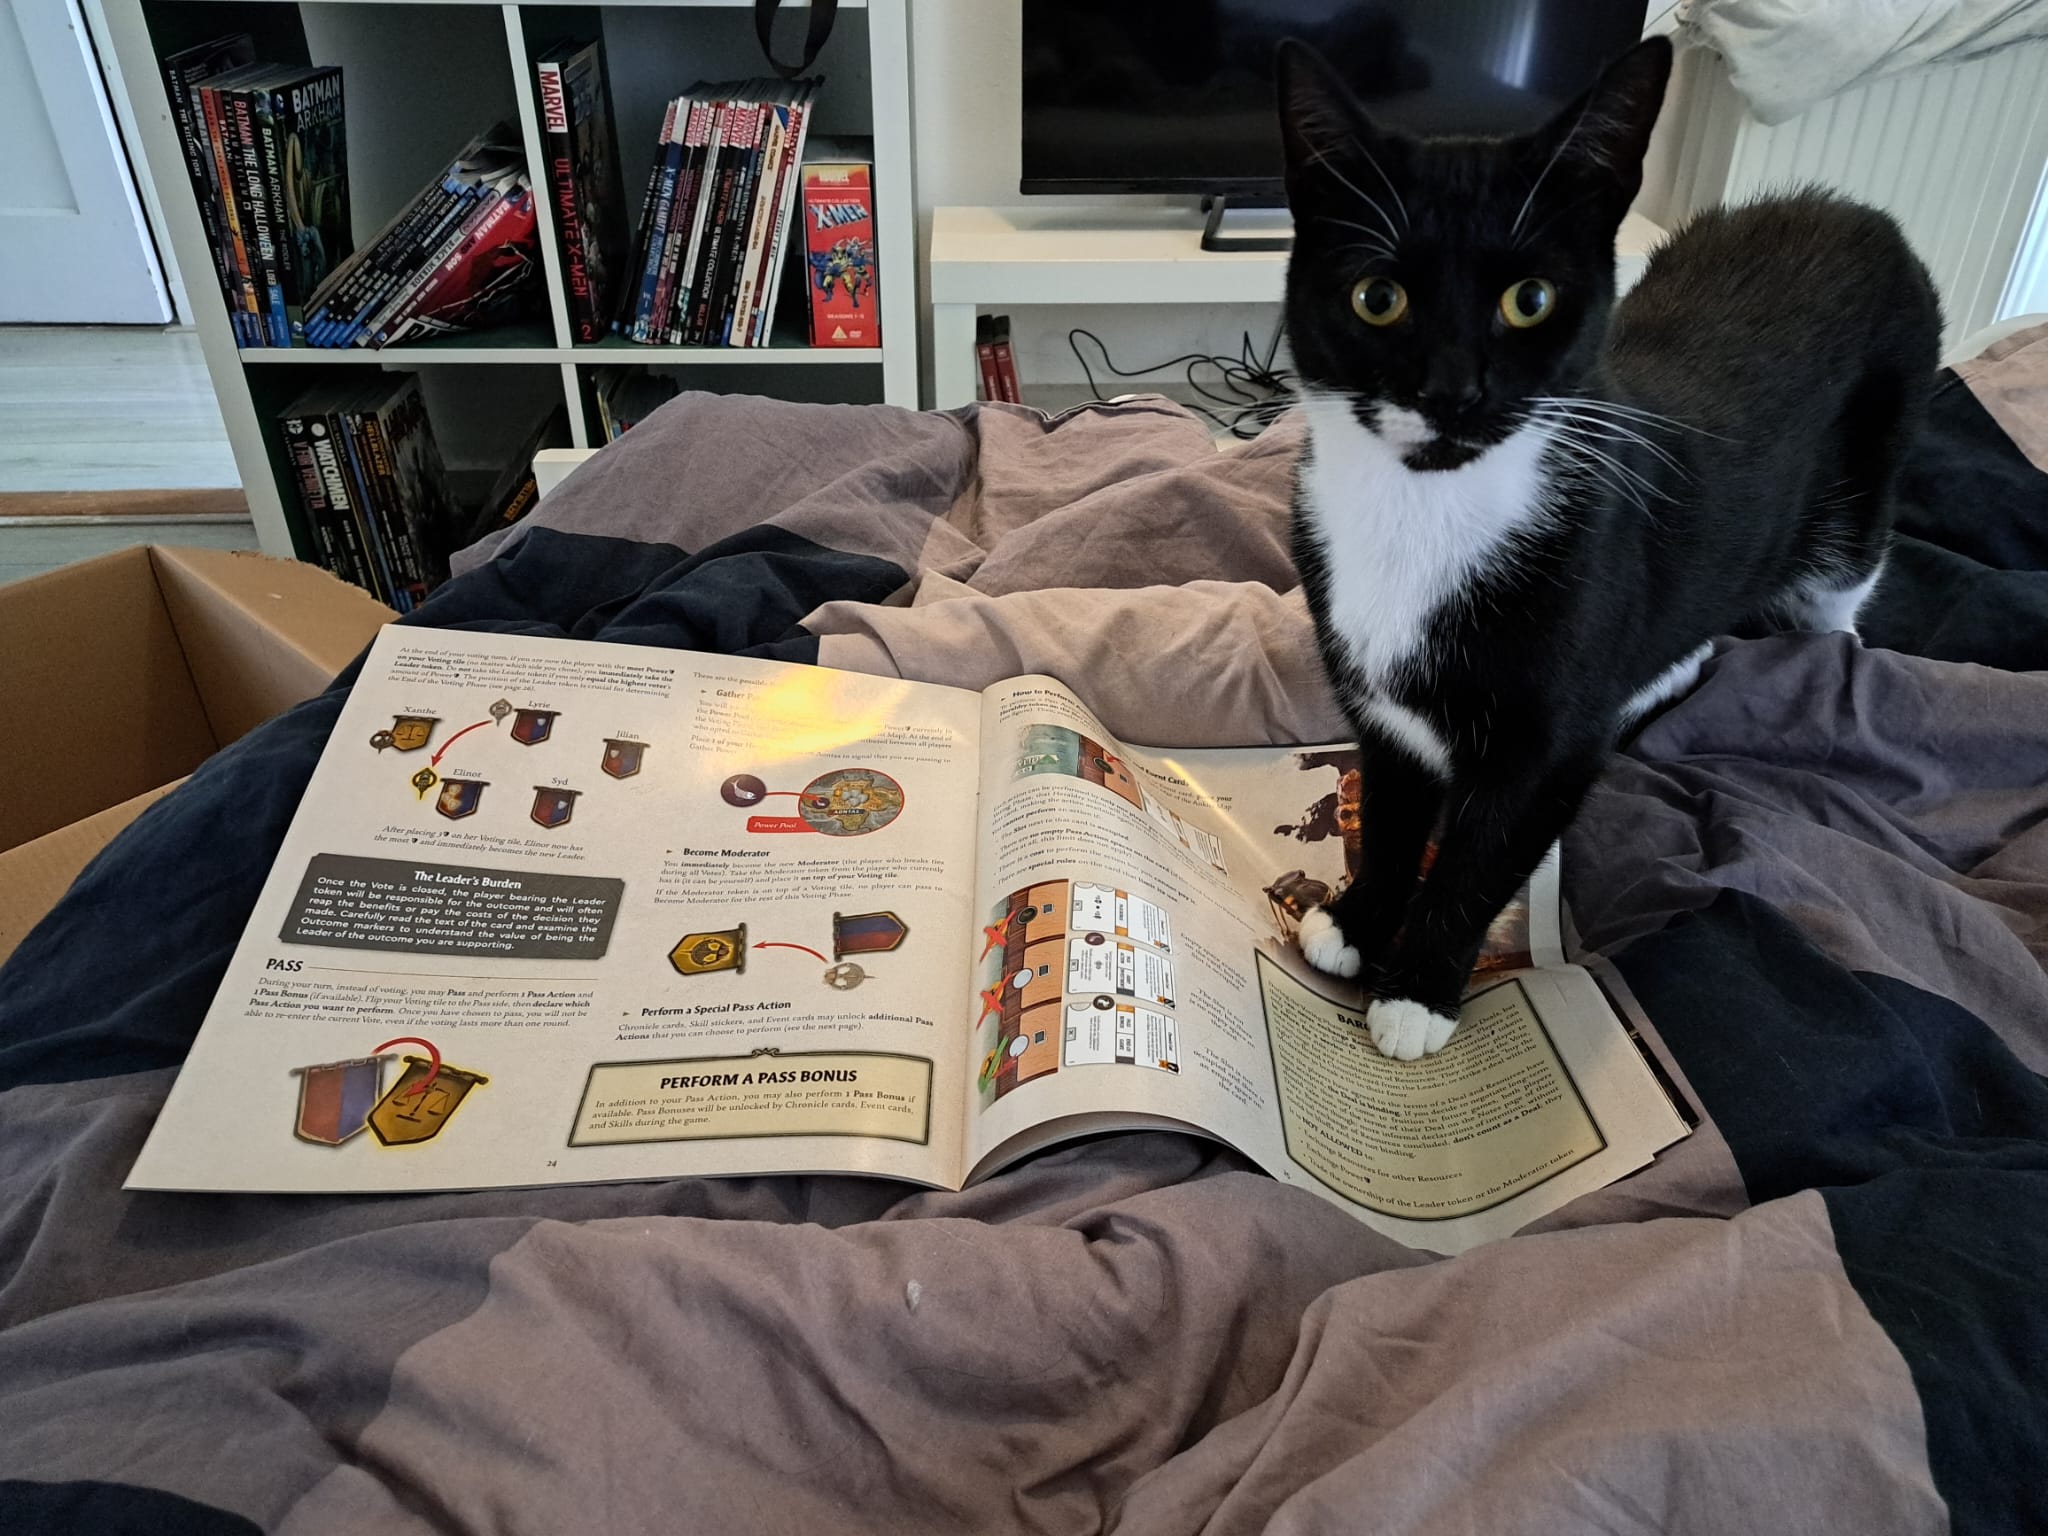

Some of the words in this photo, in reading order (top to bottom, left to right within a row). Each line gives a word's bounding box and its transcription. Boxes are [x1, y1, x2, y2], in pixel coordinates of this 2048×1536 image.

[167, 68, 184, 104] BATMAN
[291, 74, 341, 114] BATMAN
[540, 70, 566, 132] MARVEL
[189, 93, 210, 147] BATMAN
[231, 98, 253, 146] BATMAN
[296, 101, 342, 133] ARKHAM
[240, 146, 257, 169] THE
[257, 126, 280, 177] BATMAN
[244, 167, 263, 198] LONG
[663, 165, 674, 199] X-MEN
[265, 174, 289, 225] ARKHAM
[554, 158, 580, 238] ULTIMATE
[471, 198, 511, 241] BATMAN
[656, 199, 669, 232] GAMBIT
[808, 204, 869, 231] X-MEN
[249, 198, 275, 262] HALLOWEEN
[433, 238, 455, 263] BLACK
[443, 251, 463, 272] SON
[264, 267, 277, 286] LOEB
[408, 259, 436, 290] MIRROR
[562, 240, 588, 296] X-MEN
[581, 324, 592, 340] 2
[314, 439, 350, 511] WATCHMEN
[1012, 690, 1032, 698] How
[402, 705, 437, 715] Xanthe
[452, 767, 482, 778] Elinor
[550, 776, 569, 786] Syd
[778, 821, 797, 830] Pool
[682, 847, 719, 856] Become
[720, 848, 770, 857] Moderator
[1028, 859, 1055, 871] special
[316, 876, 345, 886] Once
[349, 879, 367, 888] the
[370, 881, 394, 890] Vote
[397, 882, 407, 891] is
[411, 885, 447, 896] closed,
[451, 888, 469, 897] the
[472, 890, 505, 900] player
[508, 892, 547, 904] bearing
[551, 895, 568, 904] the
[571, 897, 606, 905] Leader
[414, 870, 434, 882] The
[435, 872, 479, 885] Leader's
[481, 876, 521, 889] Burden
[313, 886, 342, 896] token
[345, 889, 365, 898] will
[367, 890, 382, 899] be
[384, 894, 443, 904] responsible
[446, 897, 462, 906] for
[465, 899, 482, 908] the
[485, 902, 530, 911] outcome
[533, 904, 554, 912] and
[555, 905, 574, 913] will
[576, 906, 603, 914] often
[295, 926, 333, 936] Leader
[334, 929, 347, 938] of
[347, 930, 365, 940] the
[367, 934, 414, 943] outcome
[414, 937, 435, 945] you
[455, 940, 514, 950] supporting.
[265, 957, 303, 972] PASS
[640, 1006, 684, 1016] Perform
[693, 1003, 730, 1015] Special
[731, 1002, 754, 1012] Pass
[755, 1001, 791, 1010] Action
[660, 1073, 739, 1089] PERFORM
[741, 1072, 753, 1085] A
[757, 1070, 796, 1084] PASS
[800, 1069, 857, 1082] BONUS
[588, 1120, 607, 1129] and
[607, 1119, 633, 1128] Skills
[634, 1118, 666, 1128] during
[667, 1116, 682, 1125] the
[682, 1116, 710, 1126] game.
[1320, 1129, 1363, 1157] ALLOWED
[546, 1159, 557, 1167] 24
[1377, 1168, 1390, 1178] for
[1392, 1173, 1416, 1182] other
[1417, 1171, 1463, 1183] Resources
[1342, 1179, 1384, 1203] ownership
[1386, 1197, 1396, 1205] of
[1413, 1198, 1445, 1208] Leader
[1447, 1192, 1474, 1206] token
[1475, 1191, 1486, 1199] or
[1486, 1184, 1502, 1195] the
[1502, 1161, 1548, 1189] Moderator
[1549, 1149, 1575, 1165] token
